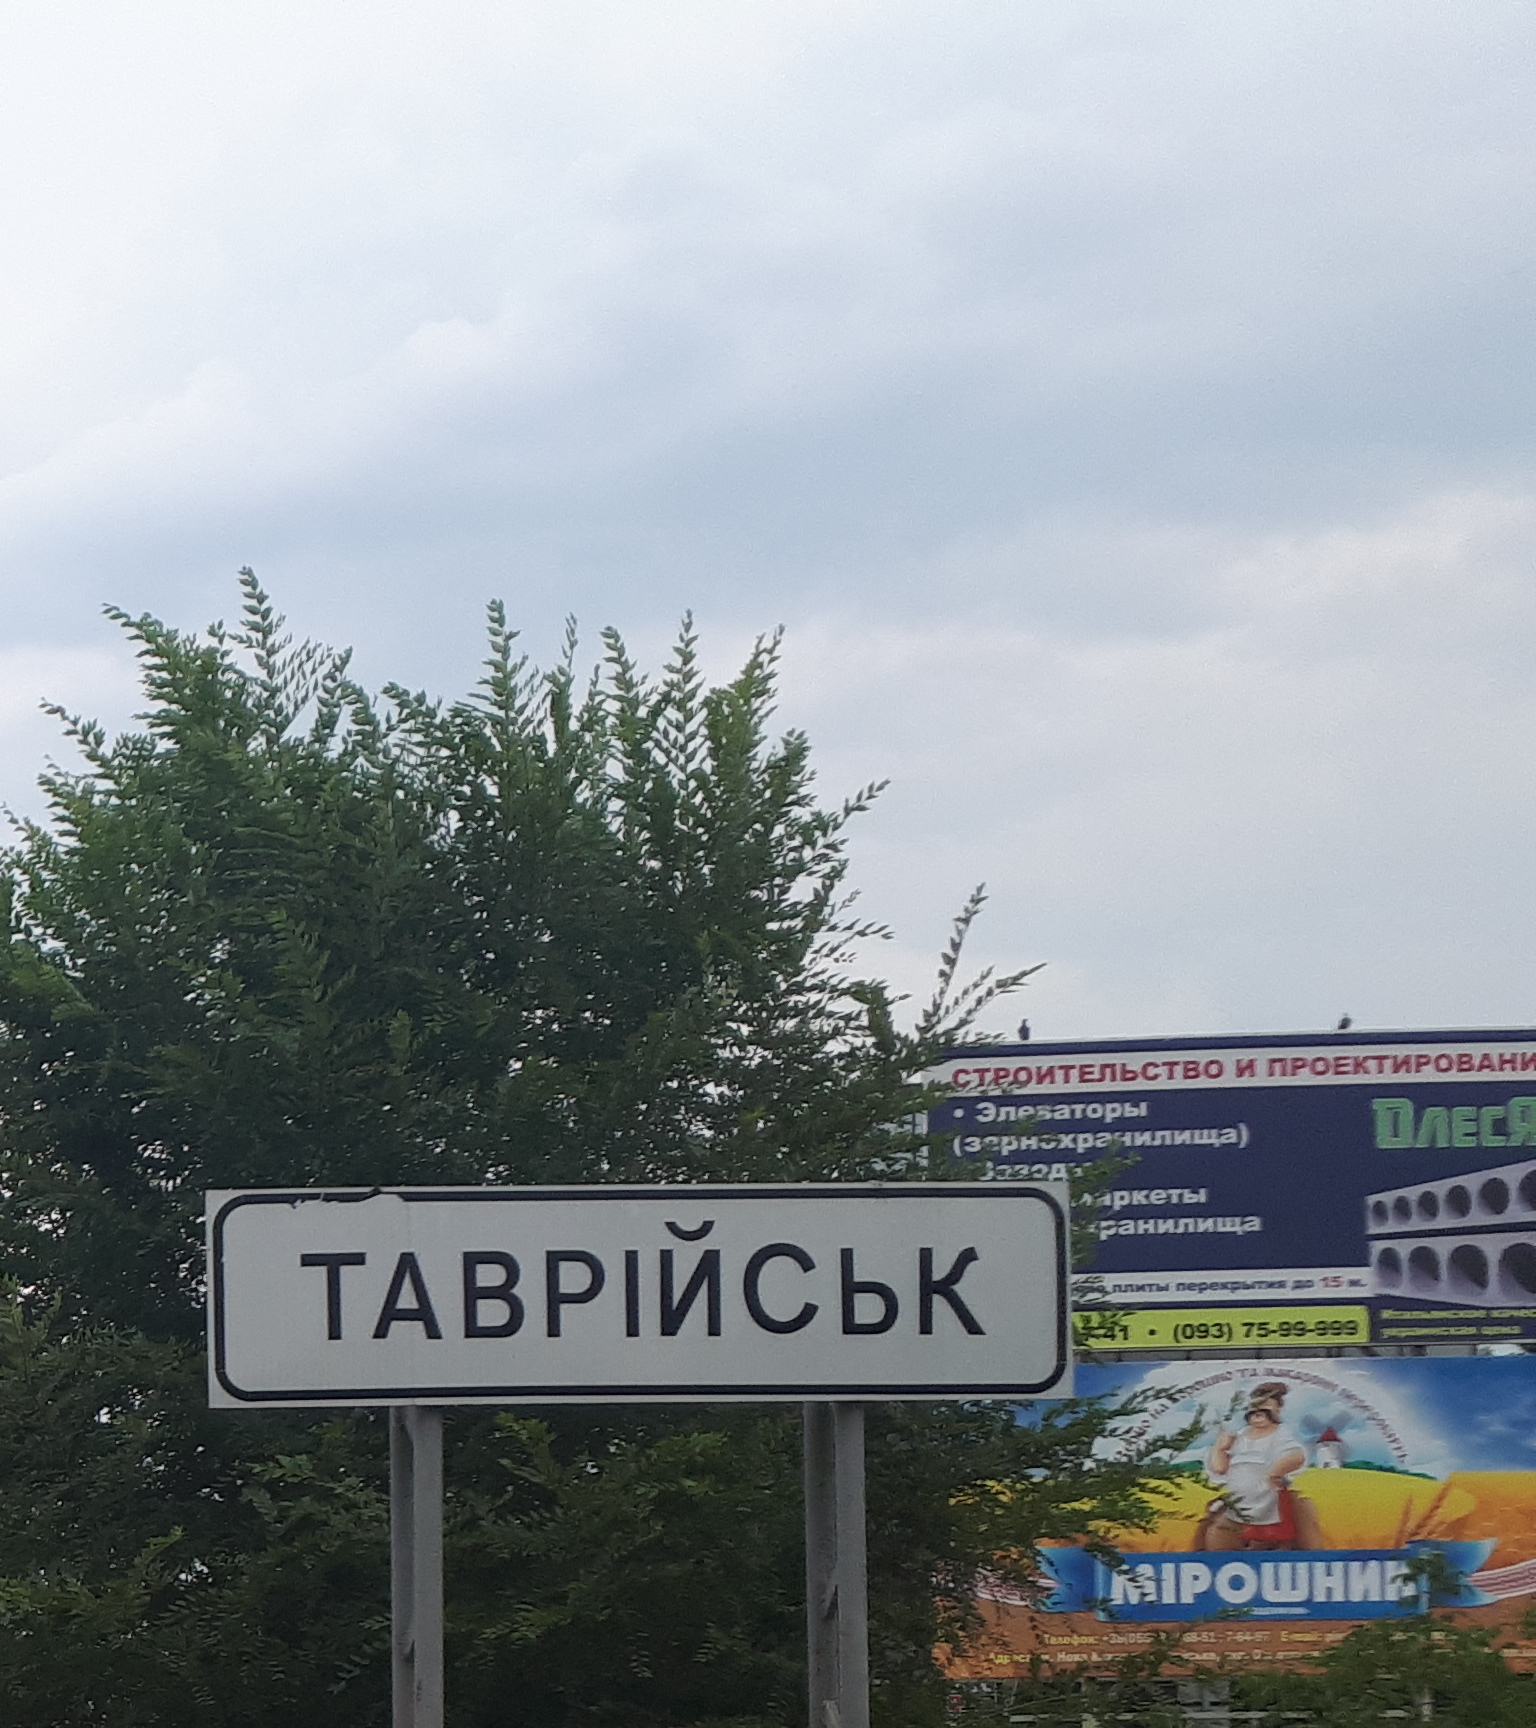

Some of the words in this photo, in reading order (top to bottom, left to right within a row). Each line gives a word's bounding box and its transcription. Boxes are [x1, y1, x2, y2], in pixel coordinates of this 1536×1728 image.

[951, 1059, 1224, 1088] СТРОИТЕЛЬСТВО
[1236, 1058, 1258, 1078] И
[975, 1101, 1148, 1124] Элеваторы
[299, 1219, 987, 1341] ТАВРІЙСЬК
[1319, 1275, 1344, 1288] 15
[1173, 1323, 1233, 1343] (093)
[1243, 1320, 1359, 1339] 75-99-999
[1110, 1559, 1417, 1605] МІРОШНИК
